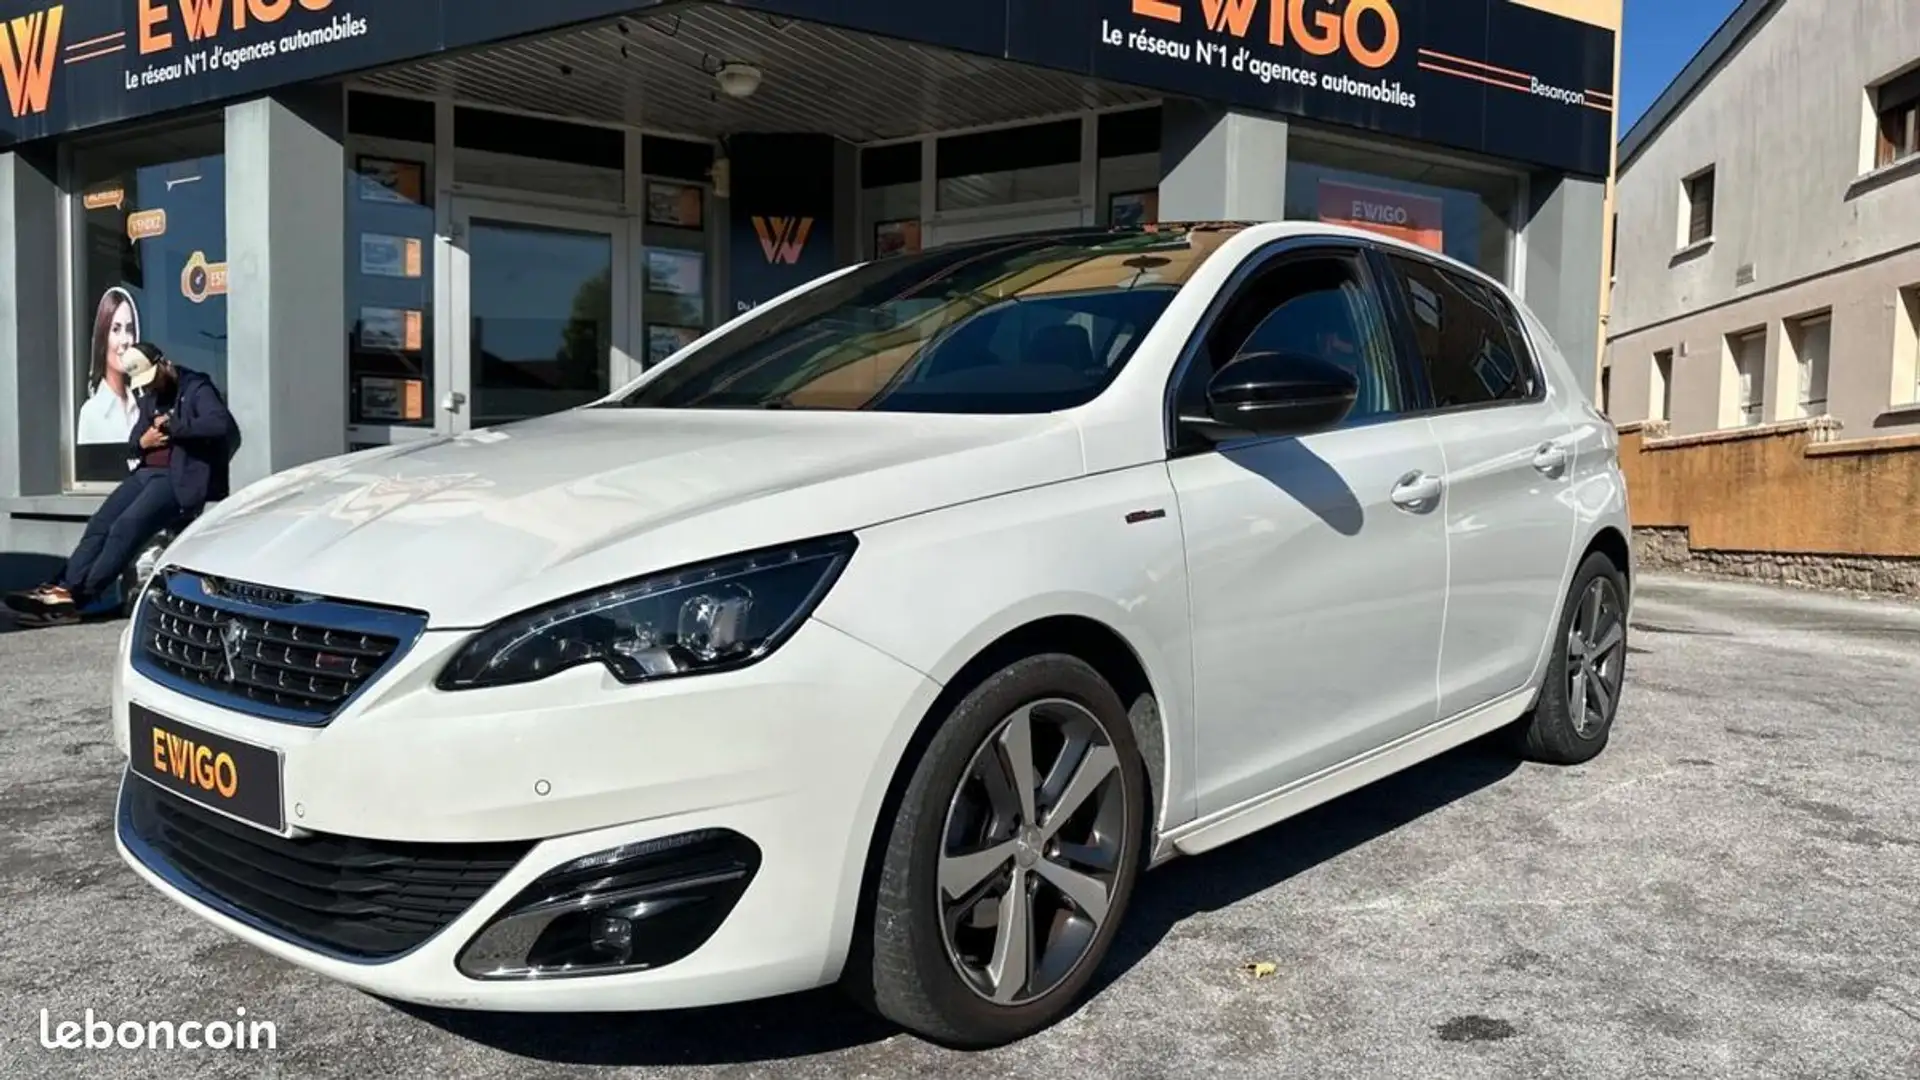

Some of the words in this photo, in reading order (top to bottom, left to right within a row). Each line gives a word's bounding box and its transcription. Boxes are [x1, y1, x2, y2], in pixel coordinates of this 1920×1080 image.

[125, 70, 139, 90] Le
[141, 63, 182, 87] réseau
[210, 39, 276, 71] d'agences
[280, 12, 367, 53] automobiles
[1102, 19, 1123, 46] Le
[1128, 28, 1191, 60] réseau
[1196, 40, 1228, 68] N°1
[1232, 47, 1318, 88] d'agences
[1321, 71, 1417, 109] automobiles
[1531, 76, 1585, 105] Besançon
[1351, 200, 1408, 224] EWIGO
[153, 727, 238, 798] EWIGO
